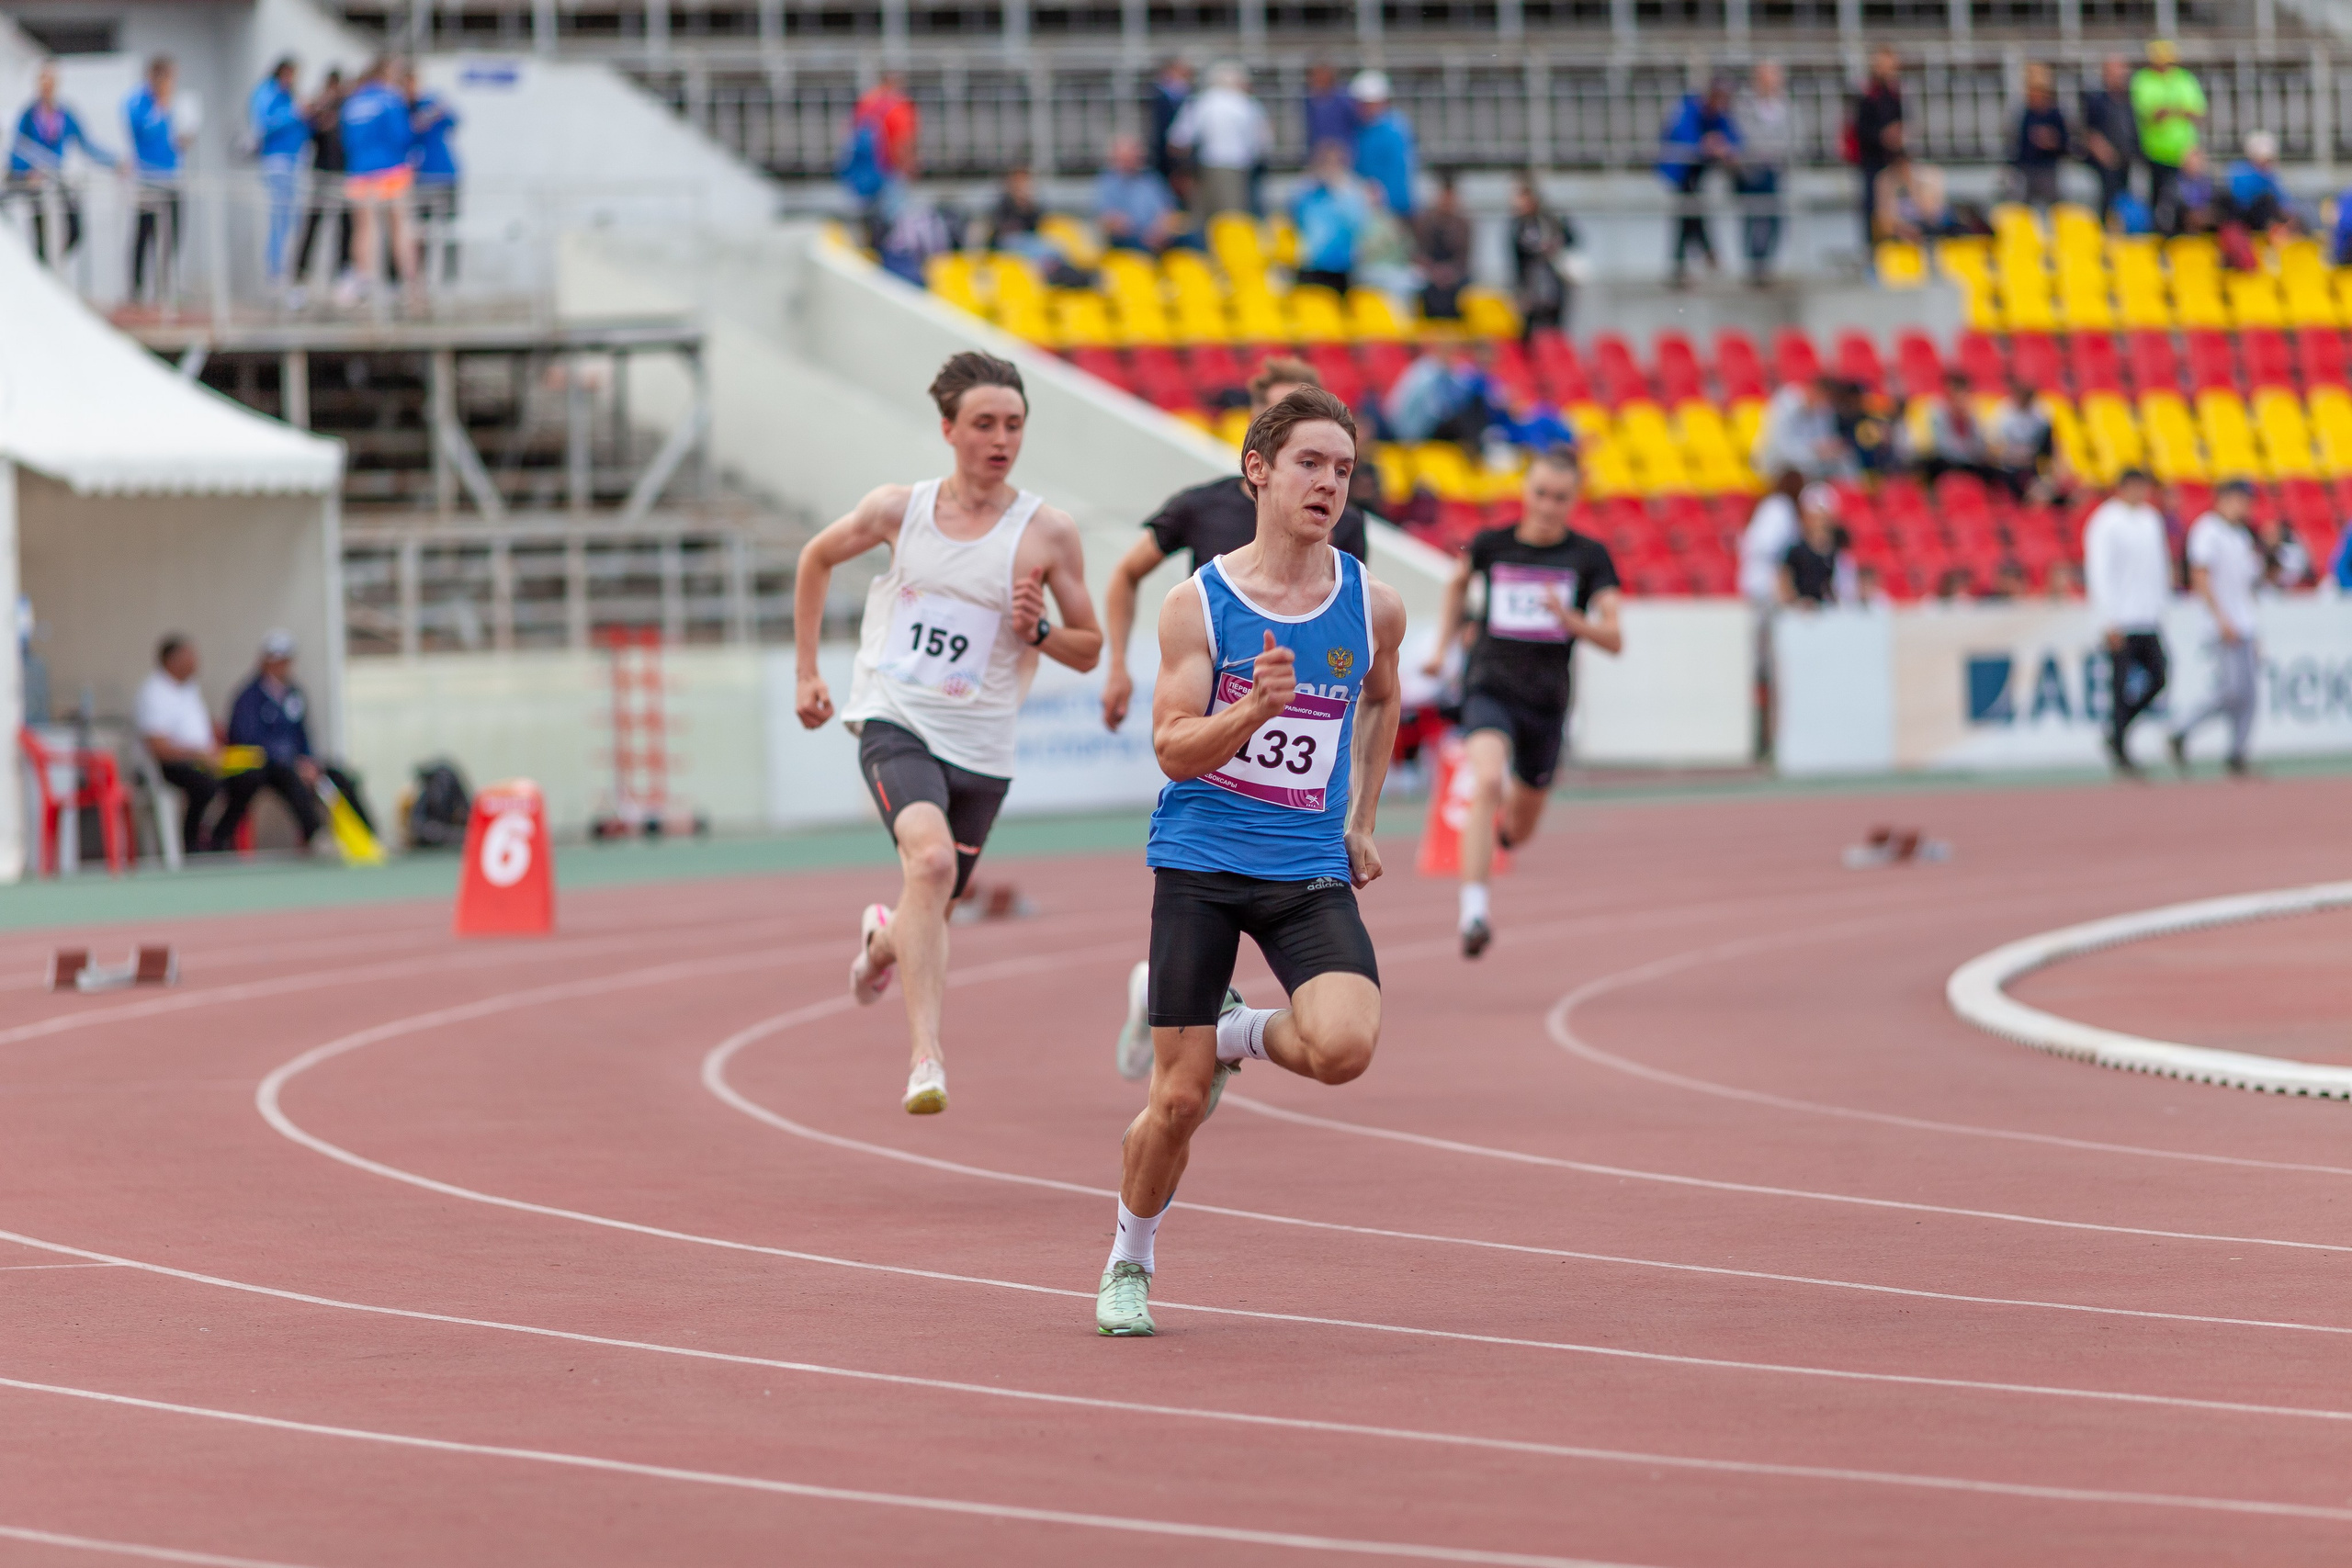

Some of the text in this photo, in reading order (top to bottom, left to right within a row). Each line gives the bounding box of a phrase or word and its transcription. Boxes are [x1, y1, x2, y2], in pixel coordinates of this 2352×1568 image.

[910, 622, 969, 663] 159
[1283, 705, 1313, 716] РАЛЬНОГО
[1313, 710, 1331, 718] ОКРУГА
[1234, 729, 1317, 774] 133
[480, 811, 536, 887] 6
[1306, 879, 1345, 891] adidas
